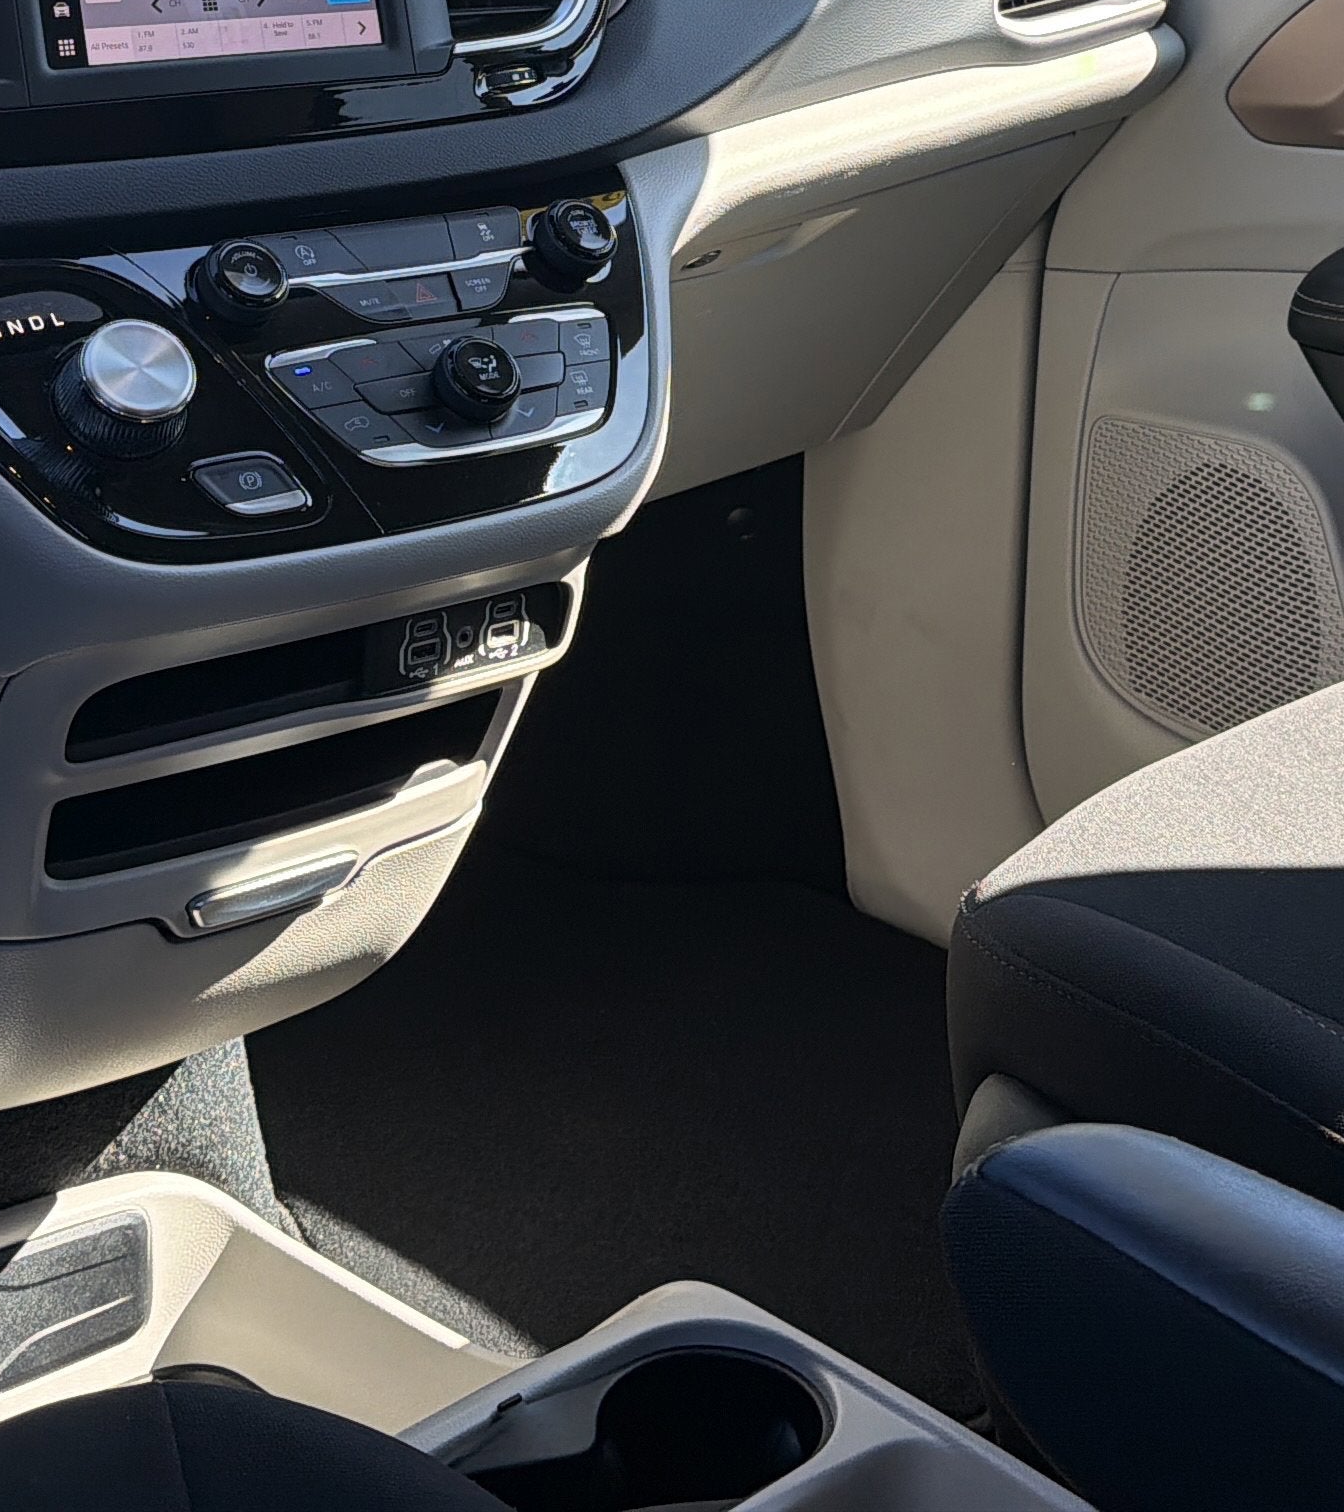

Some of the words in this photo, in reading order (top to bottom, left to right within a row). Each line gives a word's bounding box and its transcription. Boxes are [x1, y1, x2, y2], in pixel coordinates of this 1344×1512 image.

[169, 0, 182, 8] CH
[90, 42, 100, 50] All
[101, 39, 129, 50] Presets
[302, 258, 317, 266] OFF
[359, 297, 381, 307] MUTE
[312, 381, 333, 393] A/C
[399, 388, 416, 398] OFF
[453, 654, 475, 668] AUX
